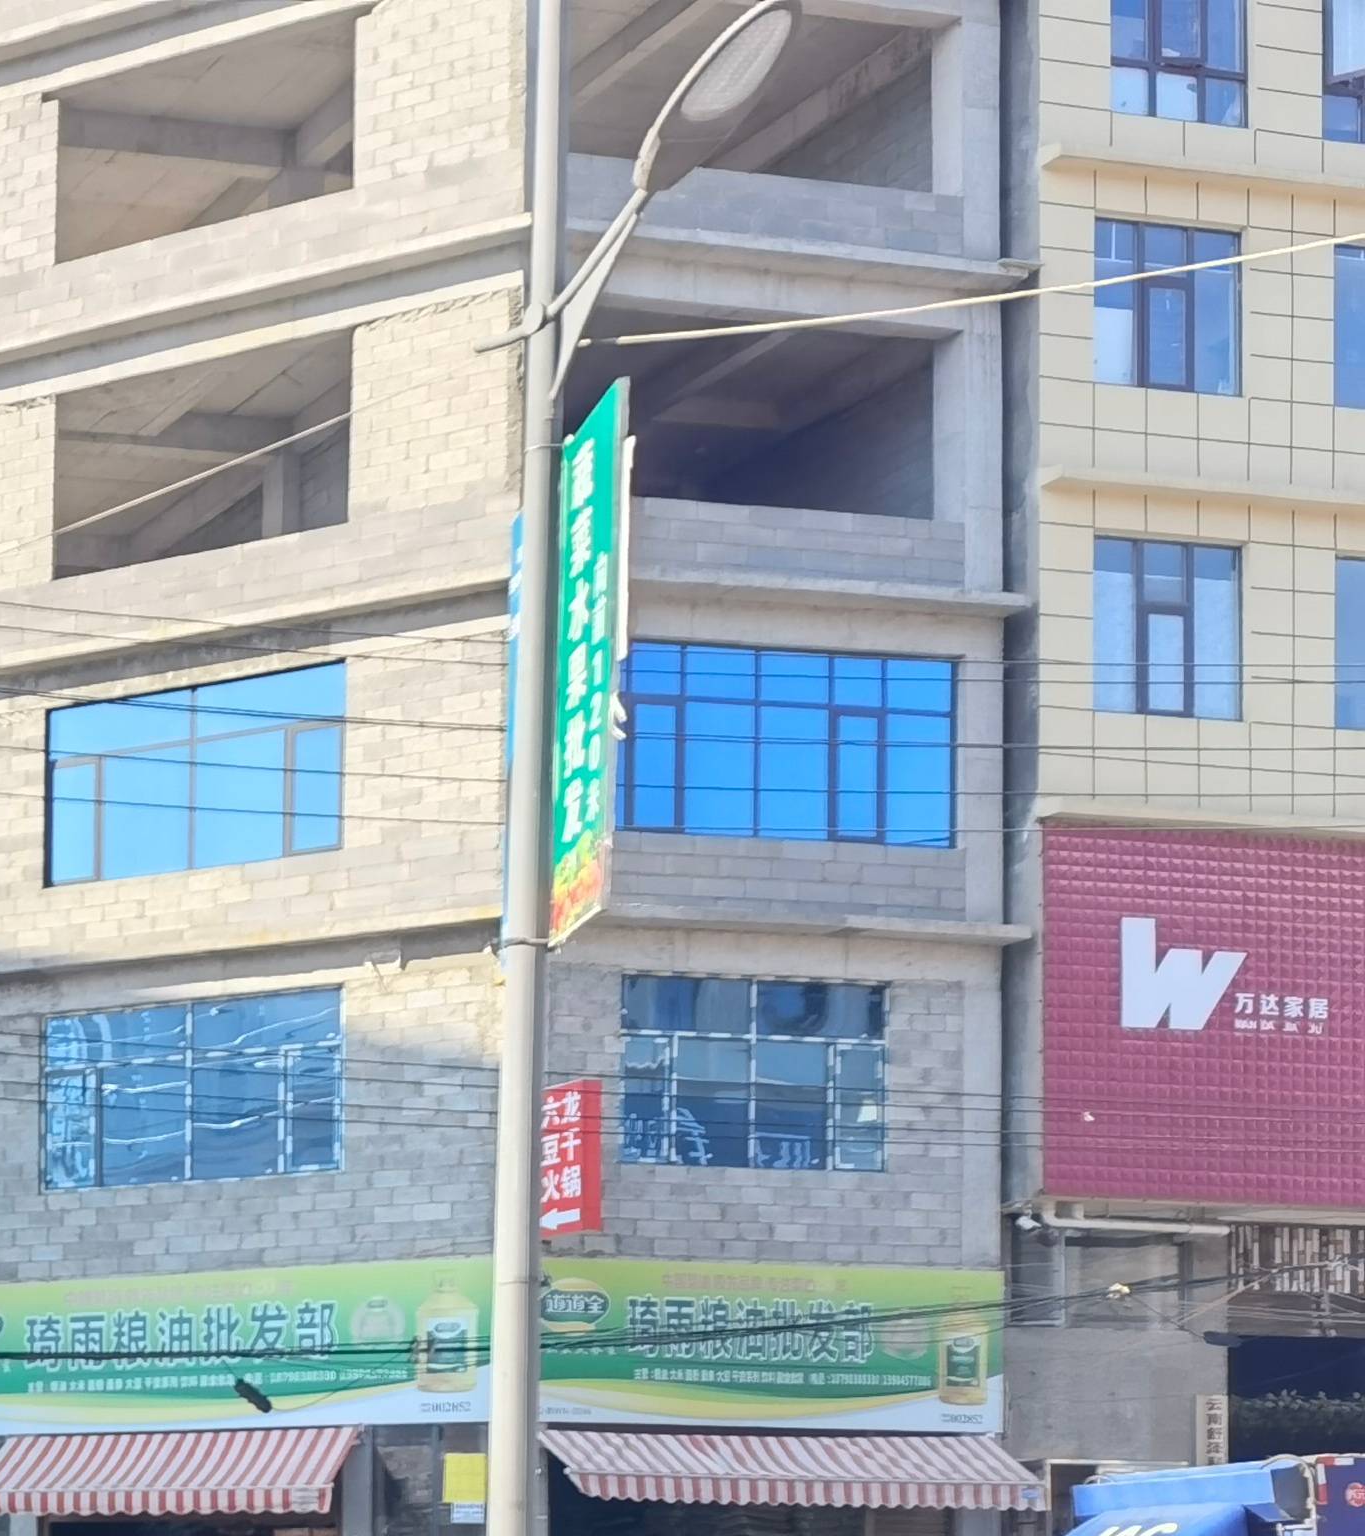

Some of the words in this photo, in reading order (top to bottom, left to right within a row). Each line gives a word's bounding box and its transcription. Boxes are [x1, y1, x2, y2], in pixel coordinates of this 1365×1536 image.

[1234, 993, 1329, 1019] 万达家居
[24, 1298, 338, 1373] 琦雨粮油批发部
